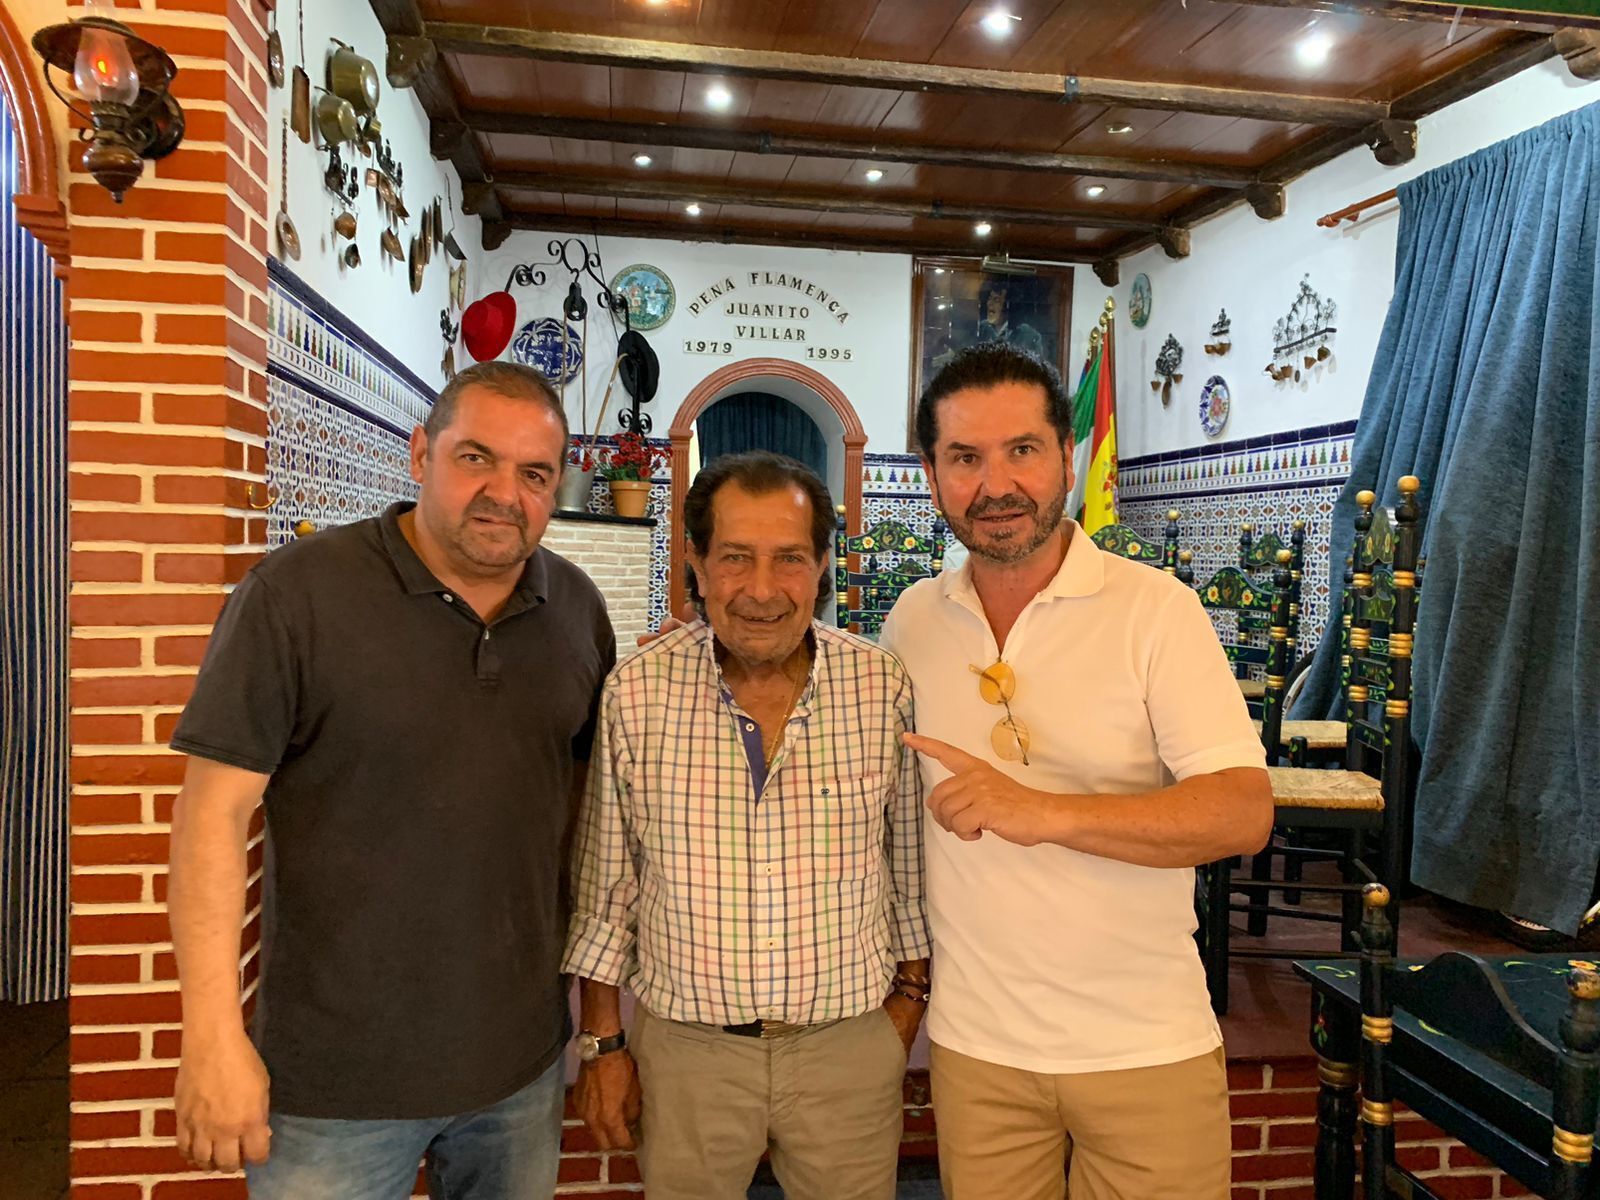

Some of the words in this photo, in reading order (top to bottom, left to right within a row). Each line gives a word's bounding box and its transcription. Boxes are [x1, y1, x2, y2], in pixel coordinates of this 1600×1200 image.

[751, 272, 849, 323] FLAMENCA
[726, 303, 809, 318] JUANITO
[736, 326, 805, 340] VILLAR
[685, 341, 732, 353] 1979
[808, 347, 851, 359] 1995
